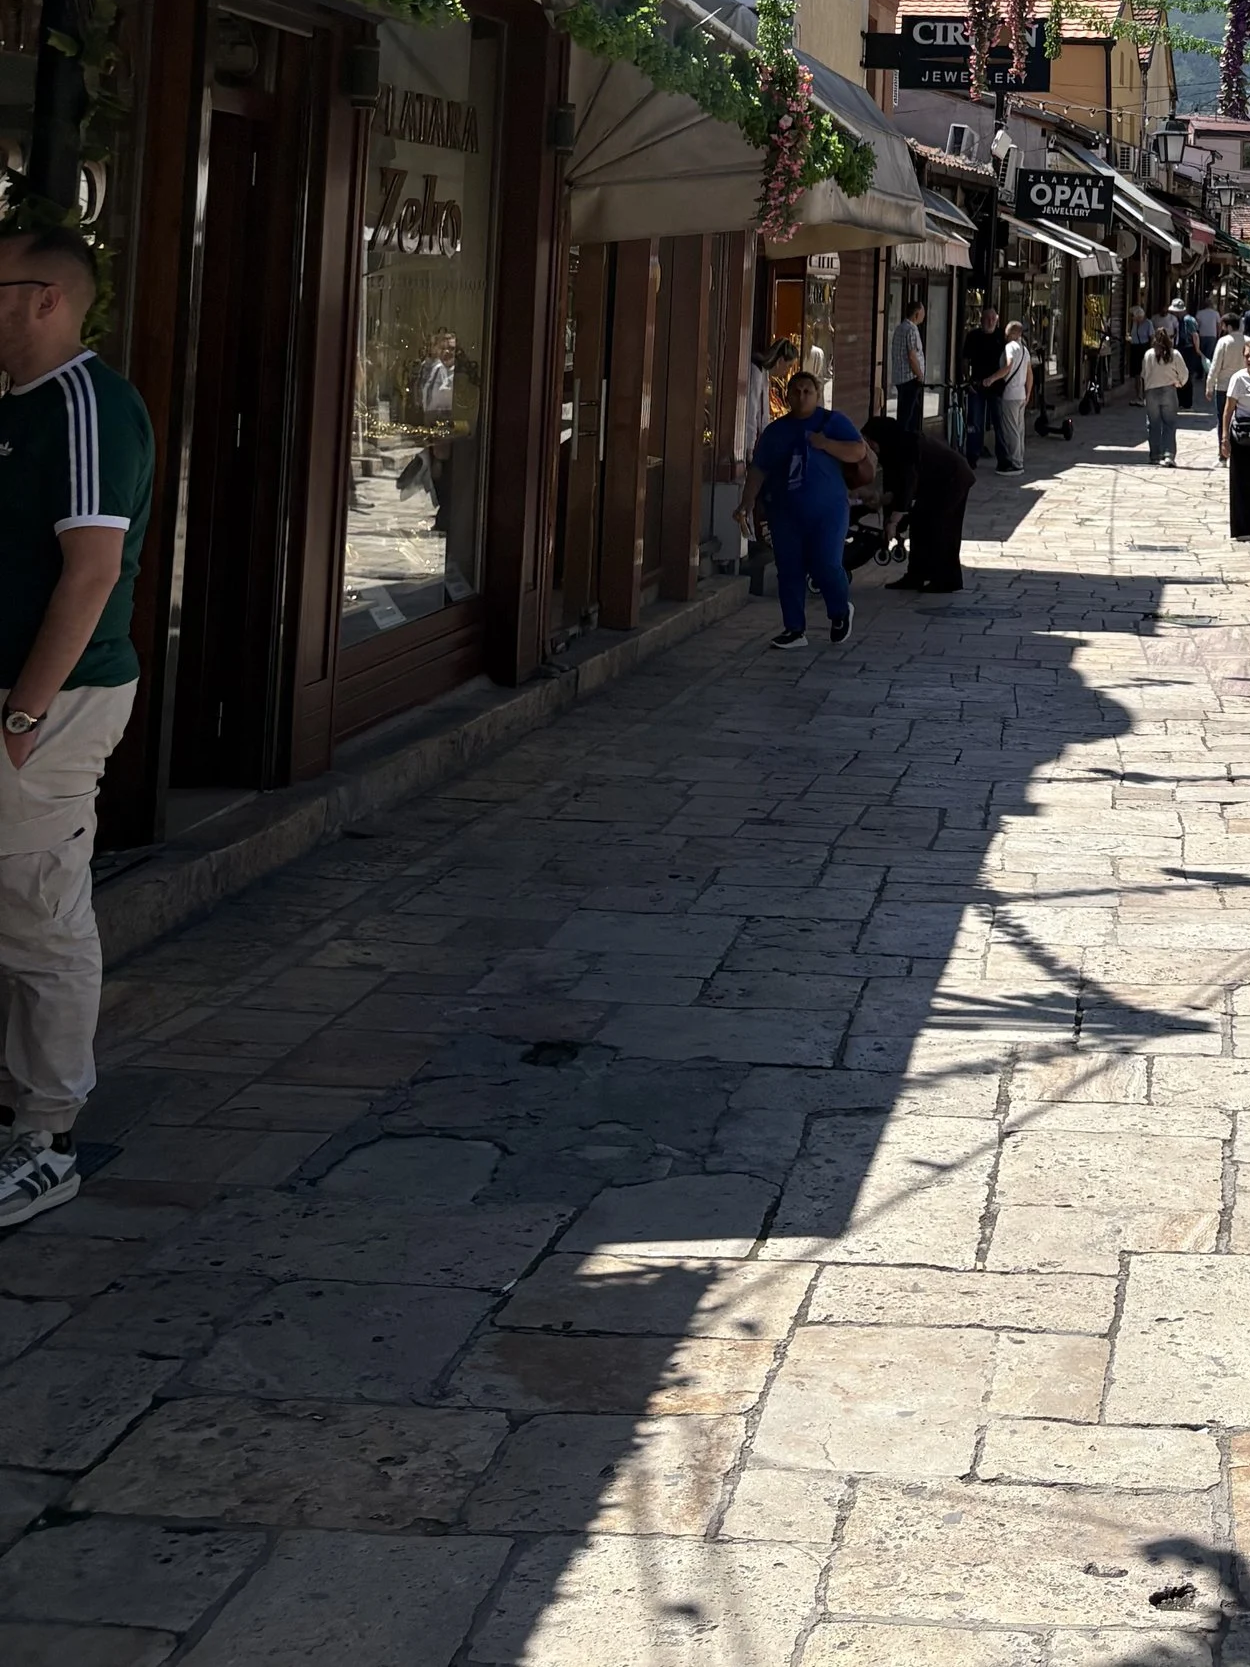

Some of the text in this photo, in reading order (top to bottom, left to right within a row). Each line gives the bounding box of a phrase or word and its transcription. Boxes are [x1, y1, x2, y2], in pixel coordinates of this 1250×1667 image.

[912, 21, 1039, 47] CIRN
[921, 70, 1028, 84] JEWEERY
[1028, 174, 1105, 187] ZLATARA
[1029, 183, 1105, 210] OPAL
[1041, 206, 1091, 217] JEWELLERY
